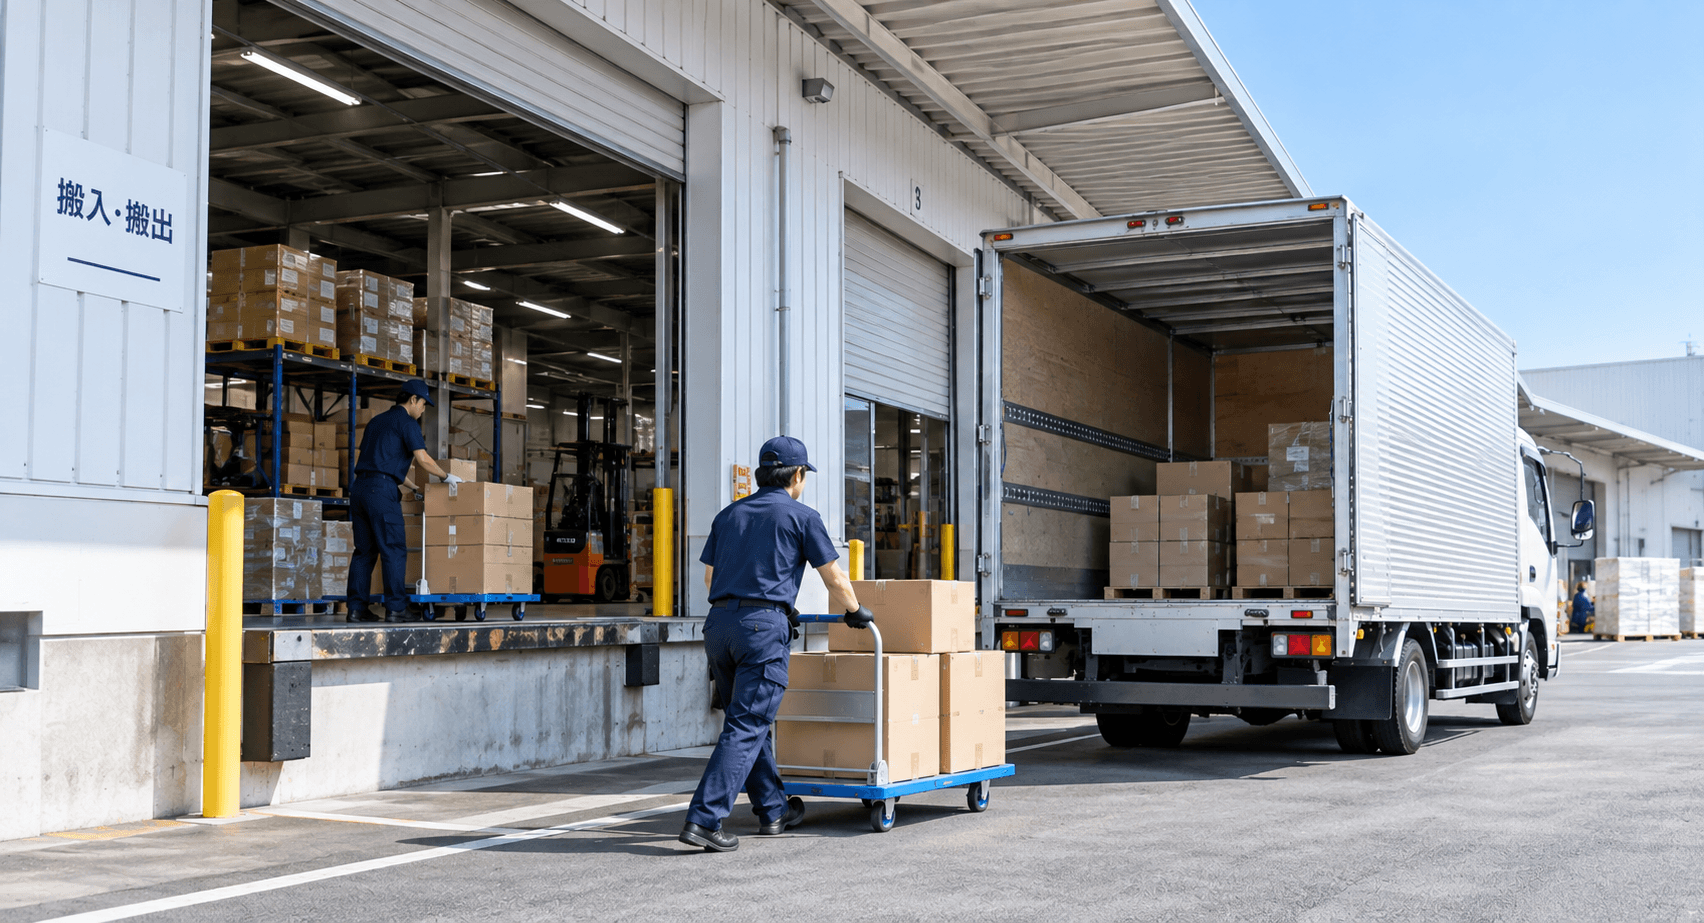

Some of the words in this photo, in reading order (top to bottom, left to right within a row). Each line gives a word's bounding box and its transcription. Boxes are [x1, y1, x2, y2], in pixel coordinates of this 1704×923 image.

[57, 177, 173, 244] 搬入・搬出
[915, 186, 921, 210] 3
